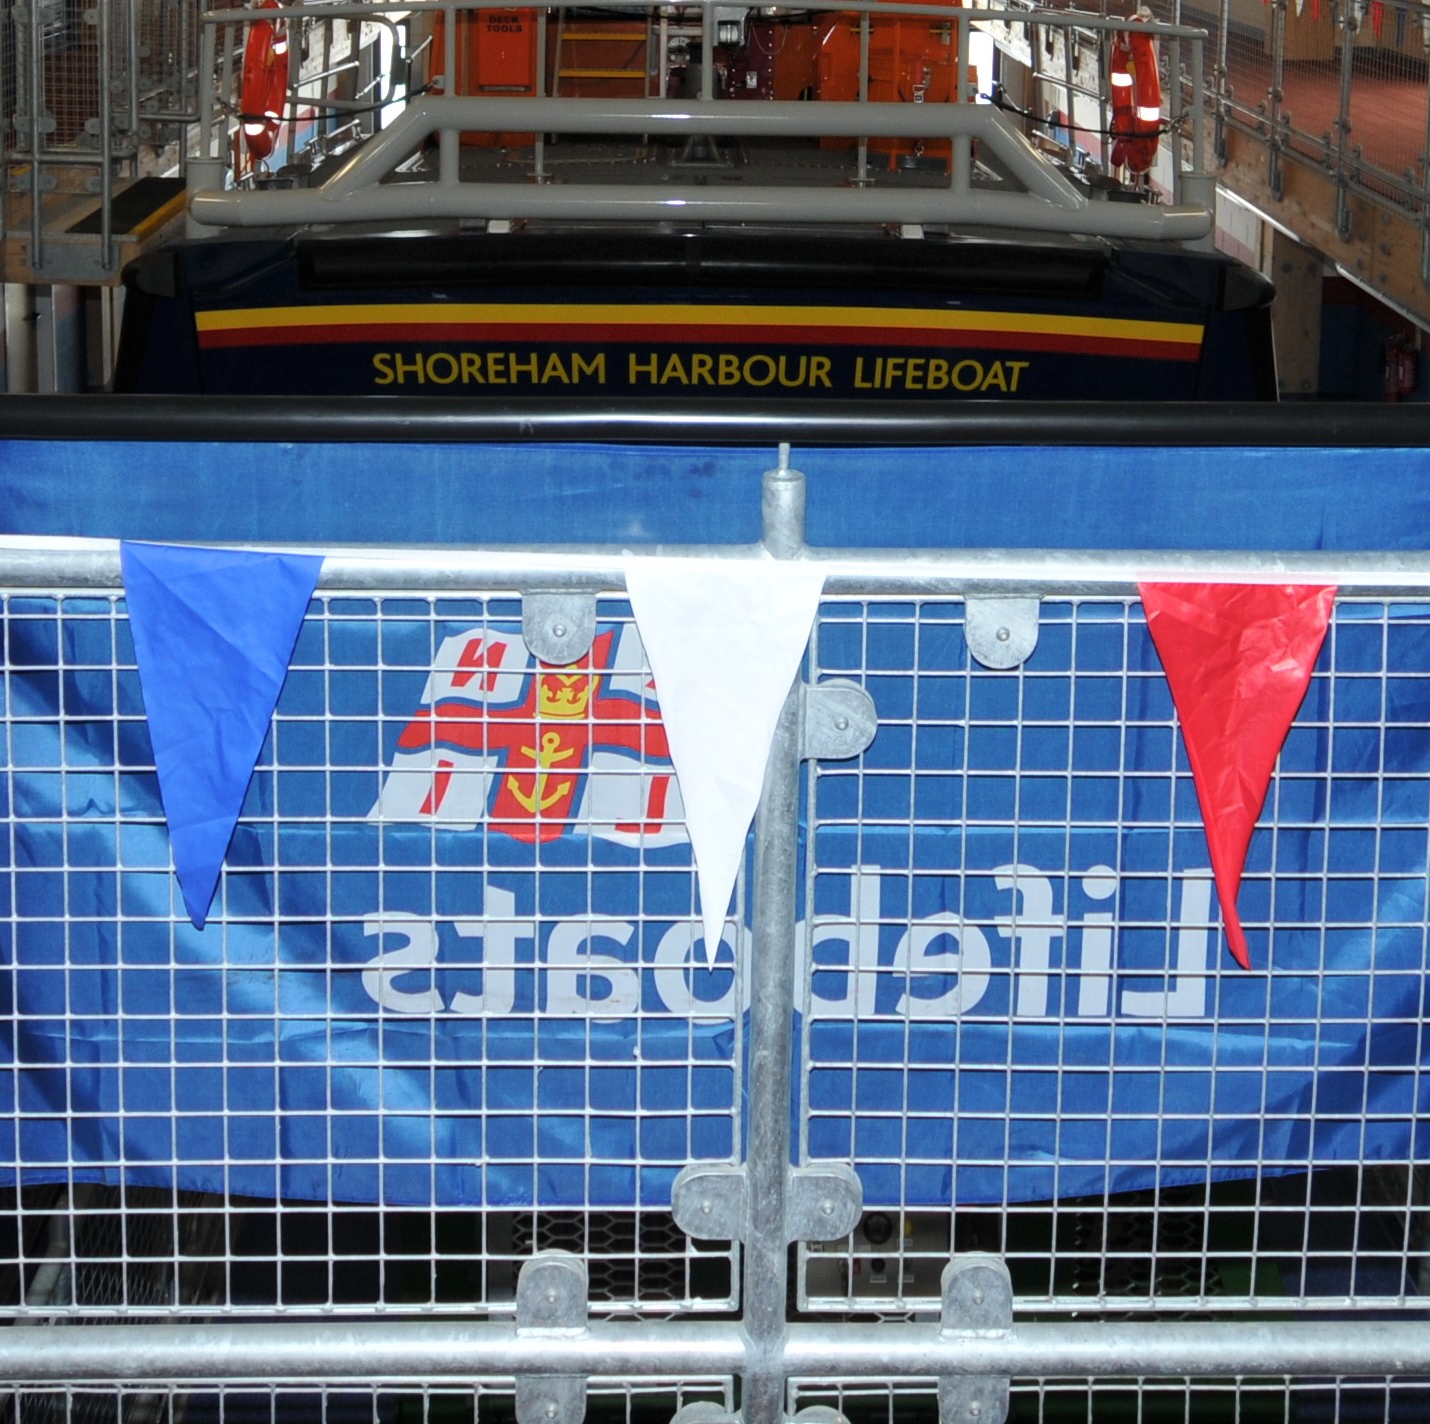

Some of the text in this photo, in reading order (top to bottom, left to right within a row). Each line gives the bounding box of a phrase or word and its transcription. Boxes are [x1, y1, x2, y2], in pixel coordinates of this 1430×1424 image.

[489, 15, 518, 24] DECK
[372, 352, 1029, 394] SHOREHAM HARBOUR LIFEBOAT
